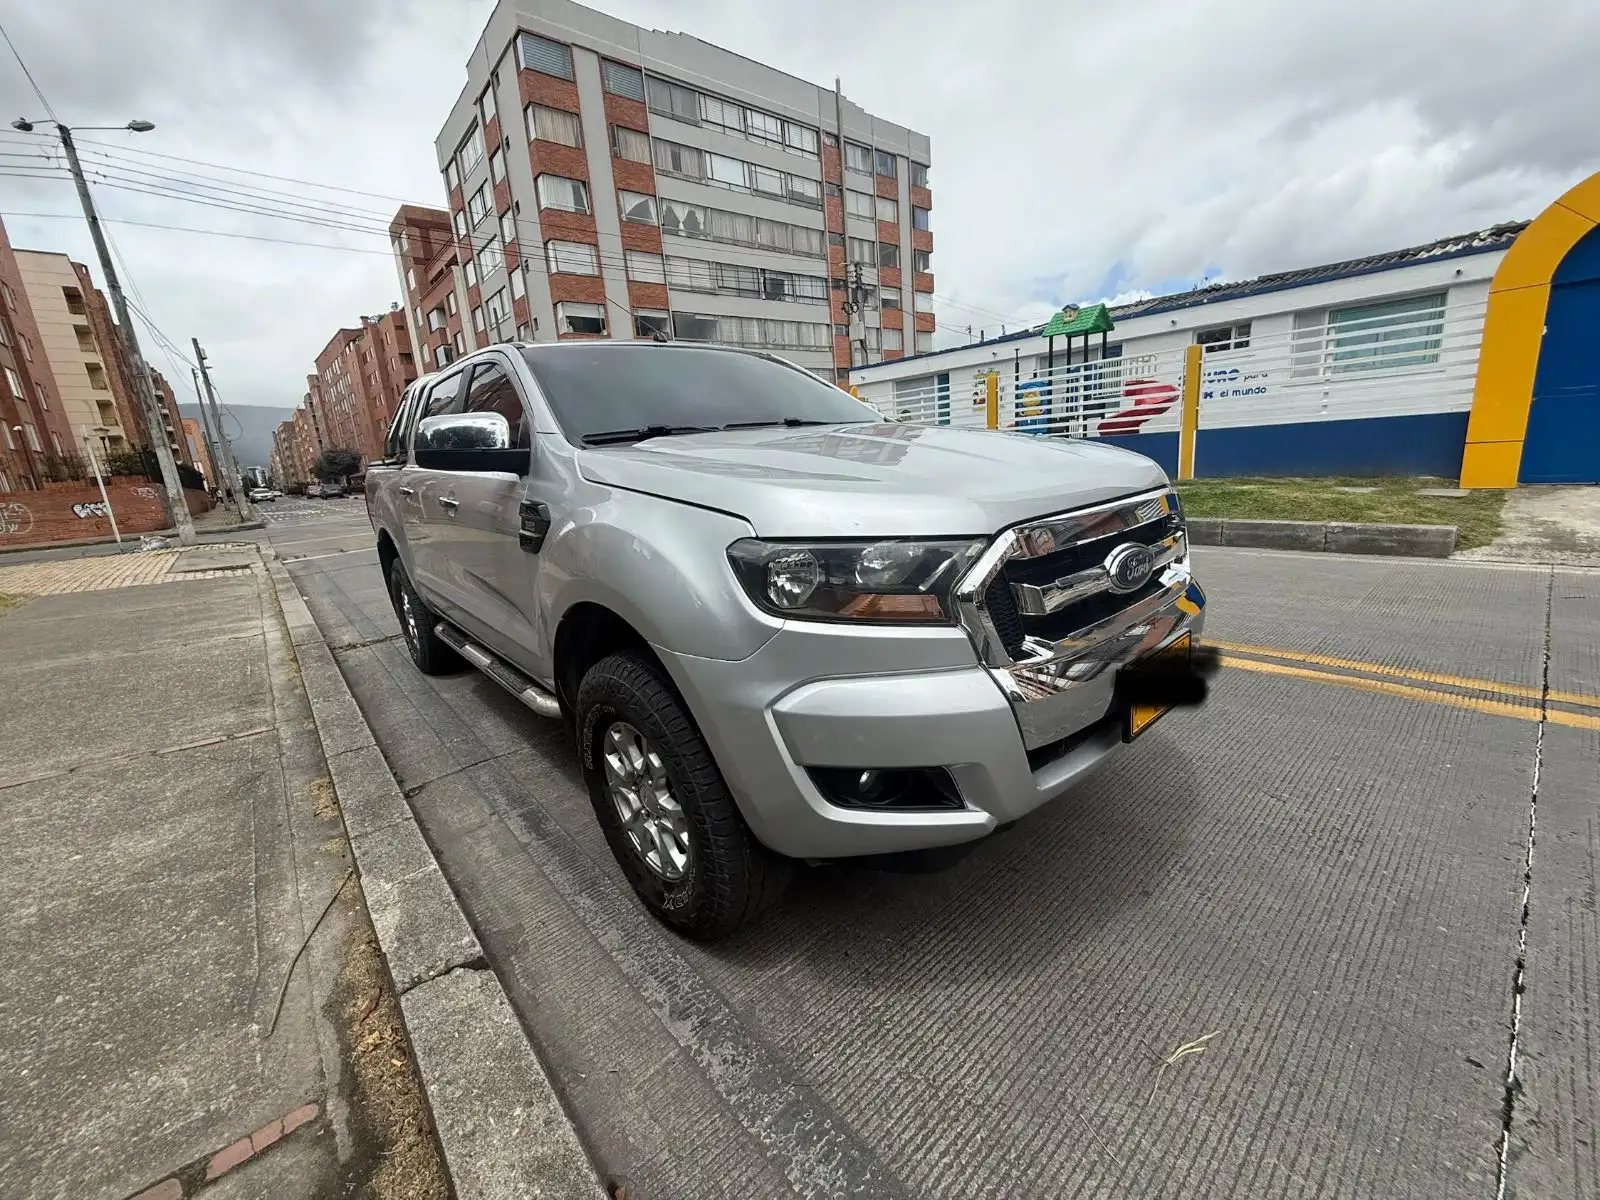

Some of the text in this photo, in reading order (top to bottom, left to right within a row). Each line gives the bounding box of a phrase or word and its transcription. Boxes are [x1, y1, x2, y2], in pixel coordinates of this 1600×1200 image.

[1220, 389, 1229, 398] el
[1232, 386, 1267, 397] mundo
[1126, 556, 1150, 580] Ford
